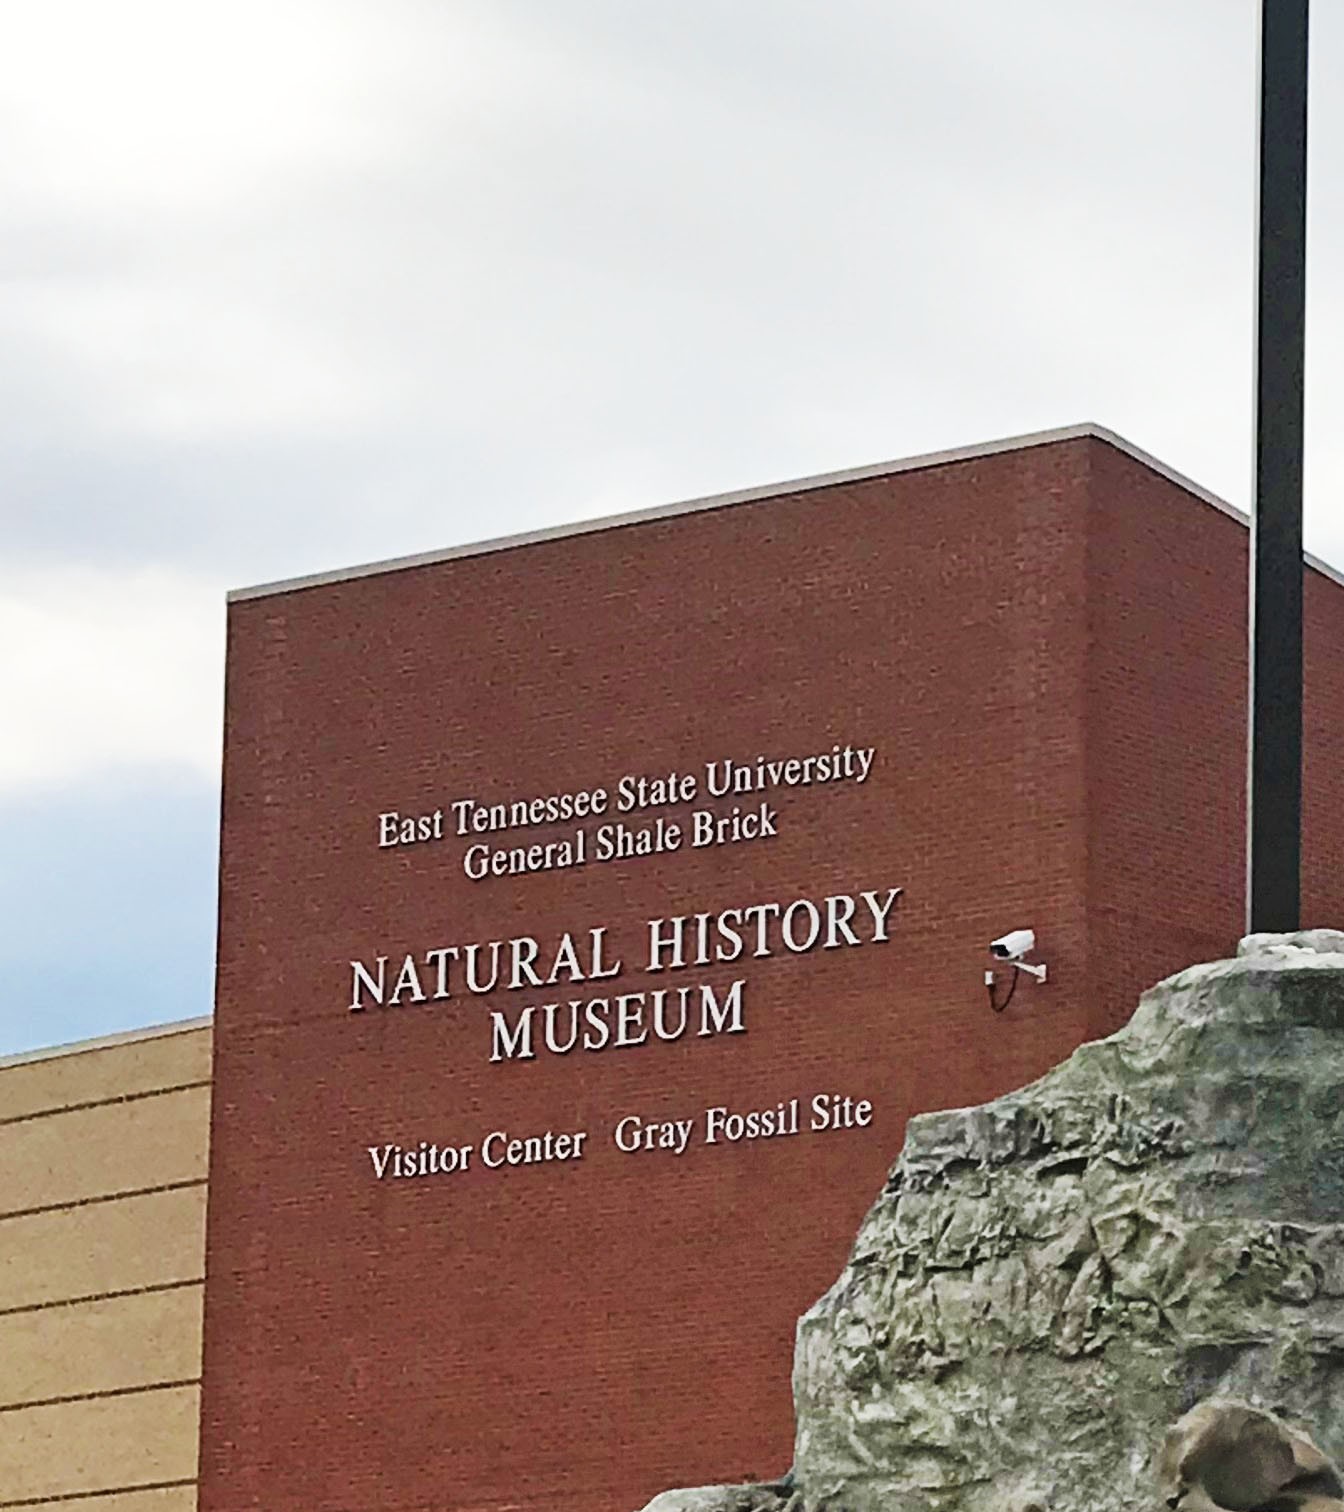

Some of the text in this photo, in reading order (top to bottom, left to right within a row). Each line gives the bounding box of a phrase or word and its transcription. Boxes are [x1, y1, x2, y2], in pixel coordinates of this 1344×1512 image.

[377, 744, 876, 848] East Tennessee State University
[462, 801, 779, 881] General Shale Brick
[347, 886, 903, 1012] NATURAL HISTORY
[487, 978, 748, 1064] MUSEUM
[366, 1093, 873, 1181] Visitor Center Gray Fossil Site
